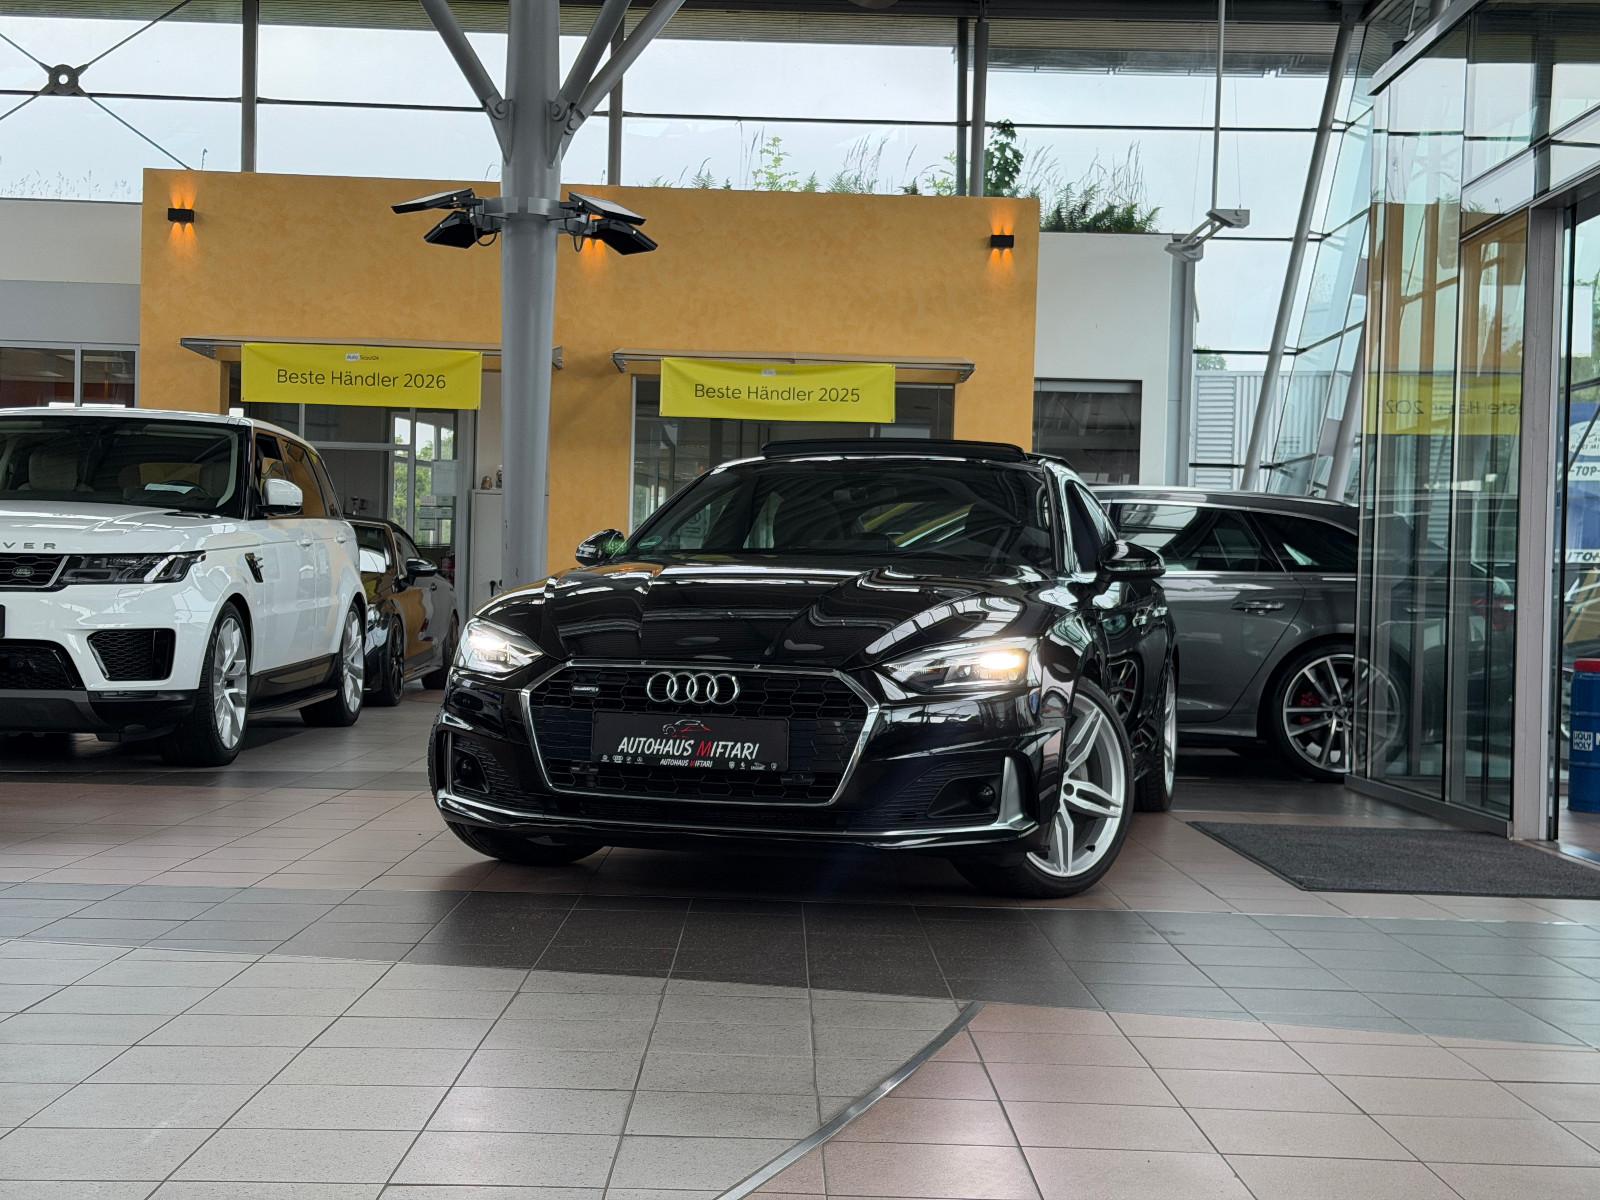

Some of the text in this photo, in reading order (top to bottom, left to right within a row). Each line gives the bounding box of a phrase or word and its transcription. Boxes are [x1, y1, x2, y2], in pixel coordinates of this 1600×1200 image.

[277, 369, 446, 389] Beste Händler 2026
[694, 383, 860, 402] Beste Händler 2025
[617, 736, 760, 760] AUTOHAUS MIFTARI
[660, 758, 689, 767] AUTOHAUS
